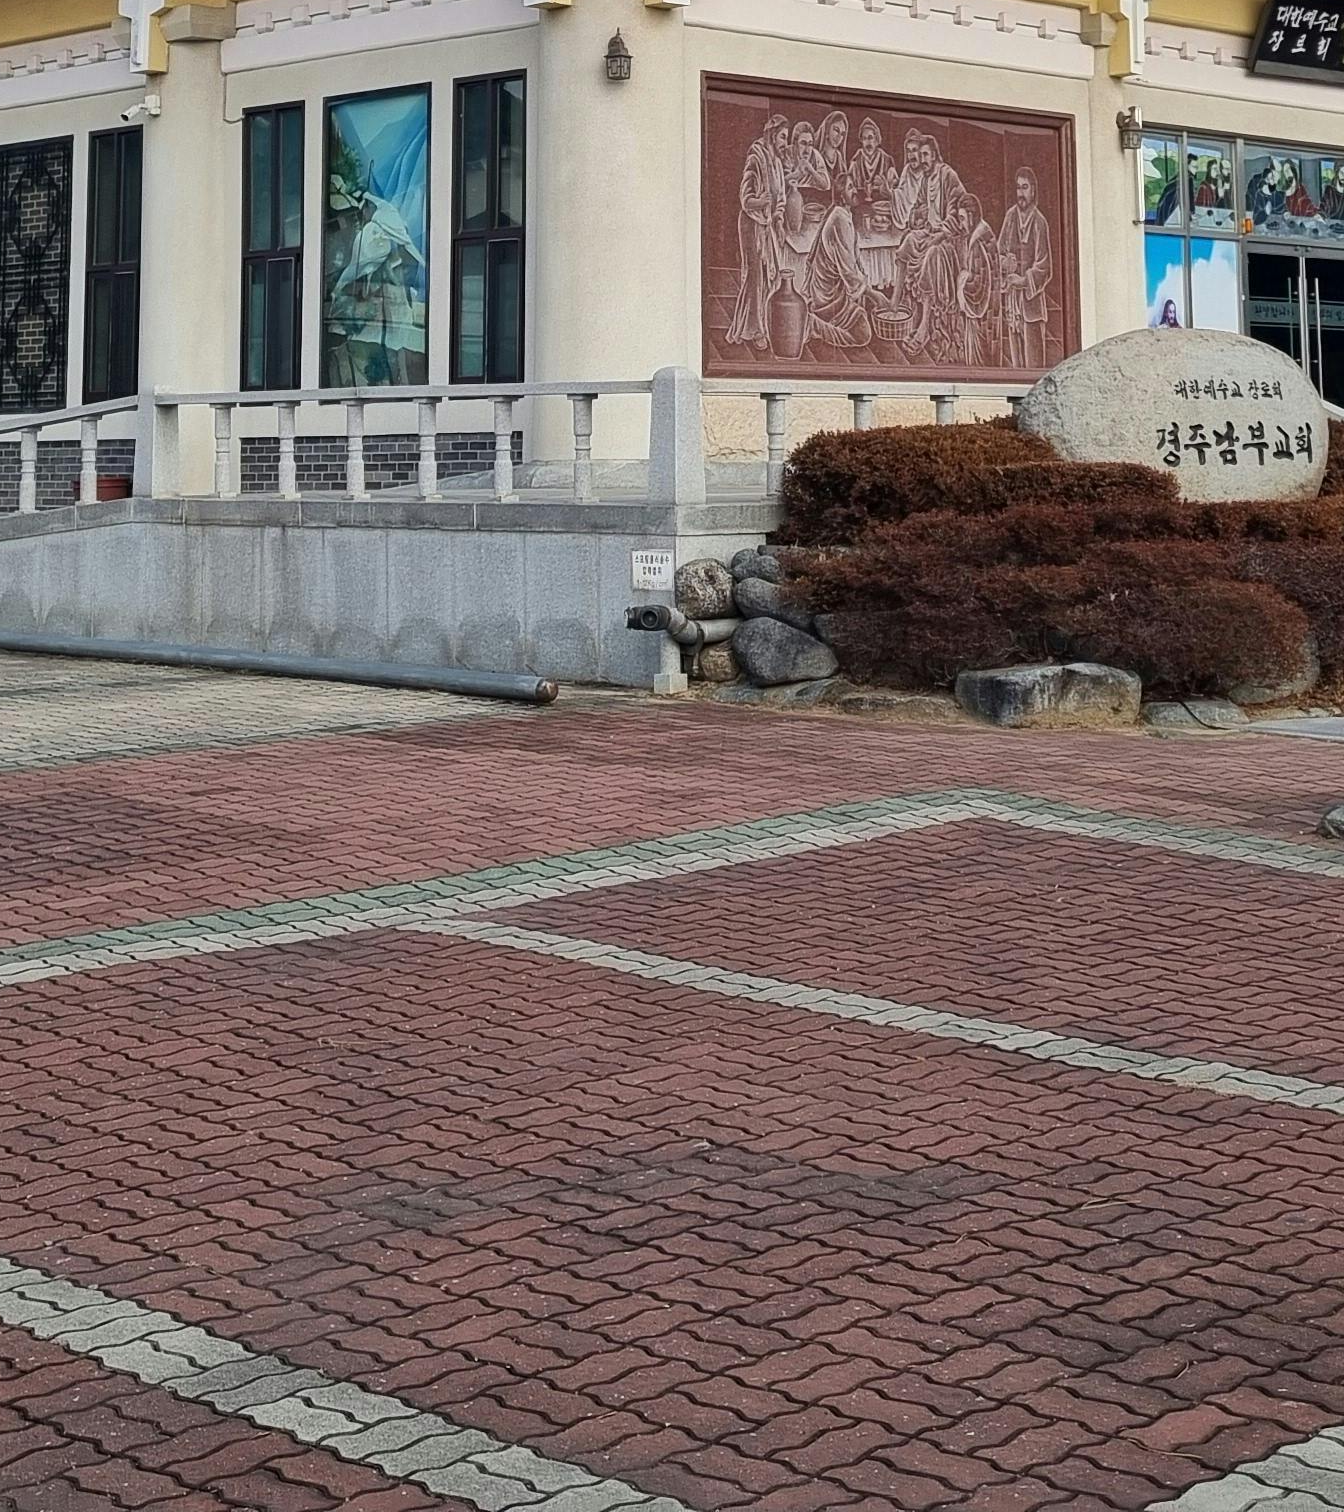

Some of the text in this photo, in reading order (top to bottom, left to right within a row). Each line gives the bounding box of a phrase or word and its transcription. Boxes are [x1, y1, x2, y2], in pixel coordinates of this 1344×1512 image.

[1276, 5, 1340, 32] 대한예수교
[1173, 378, 1283, 400] 대한예수교 장로회
[1156, 420, 1313, 467] 경주남부교회
